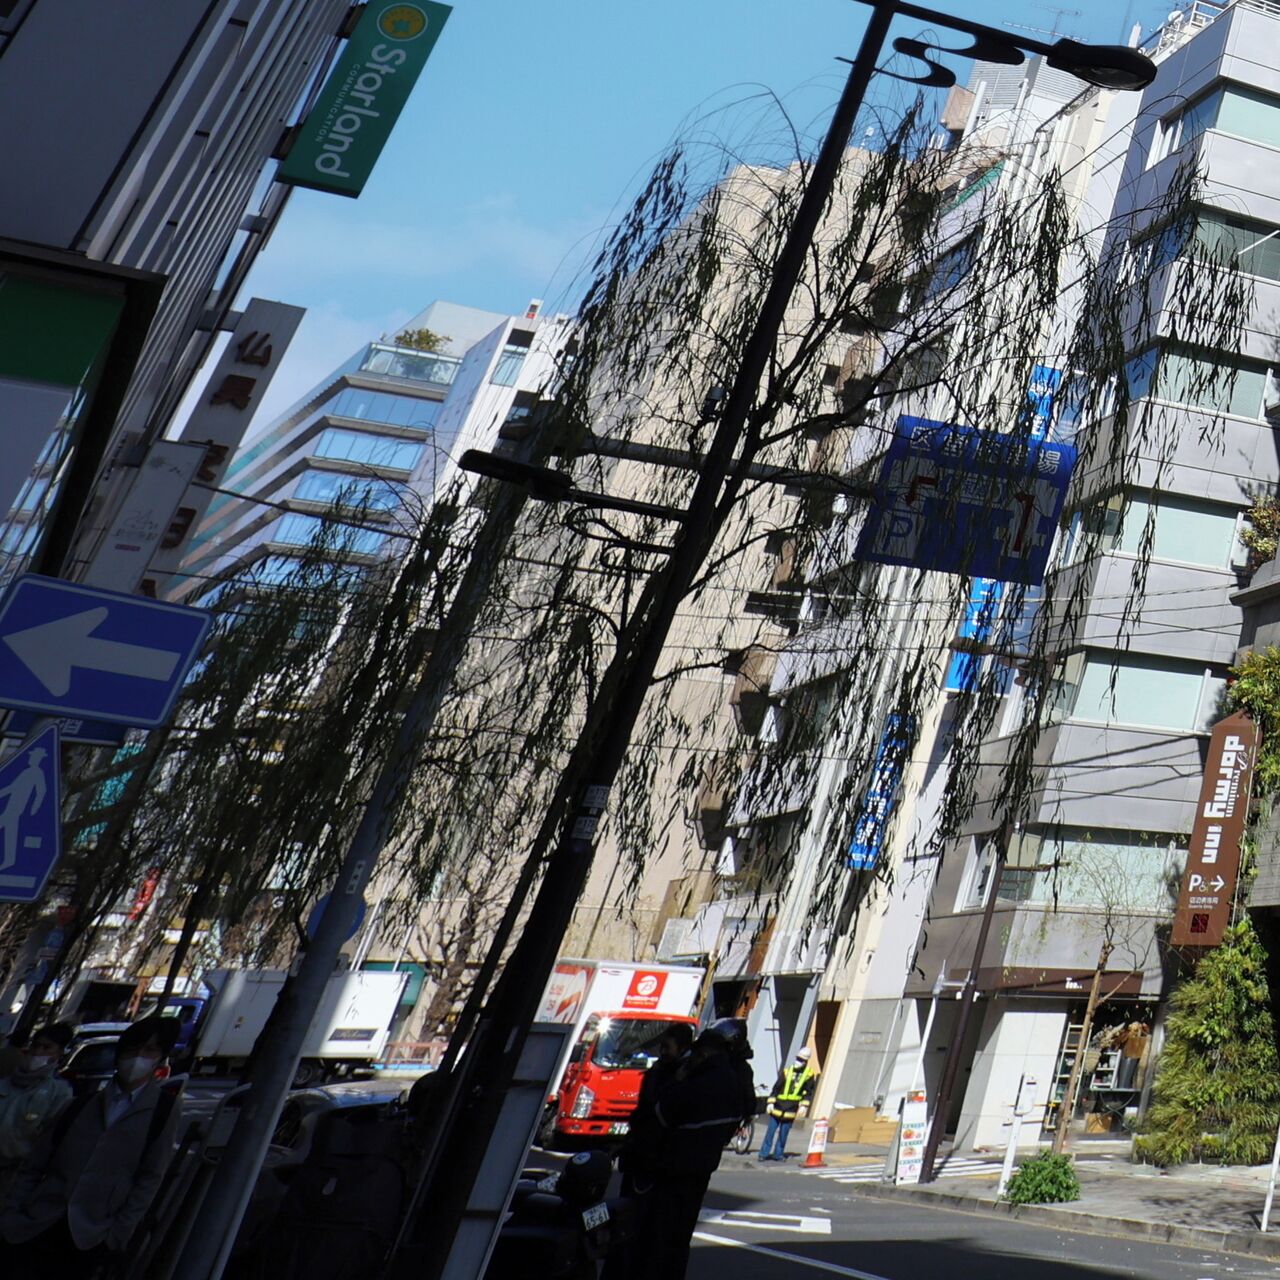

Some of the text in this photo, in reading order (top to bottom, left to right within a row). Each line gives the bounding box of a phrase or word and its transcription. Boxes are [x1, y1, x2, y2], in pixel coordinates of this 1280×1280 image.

[315, 63, 361, 142] COMMUNICATION
[315, 43, 407, 178] Starland
[1201, 735, 1245, 864] dormy inn
[1225, 750, 1249, 818] Premium
[1188, 874, 1202, 892] P
